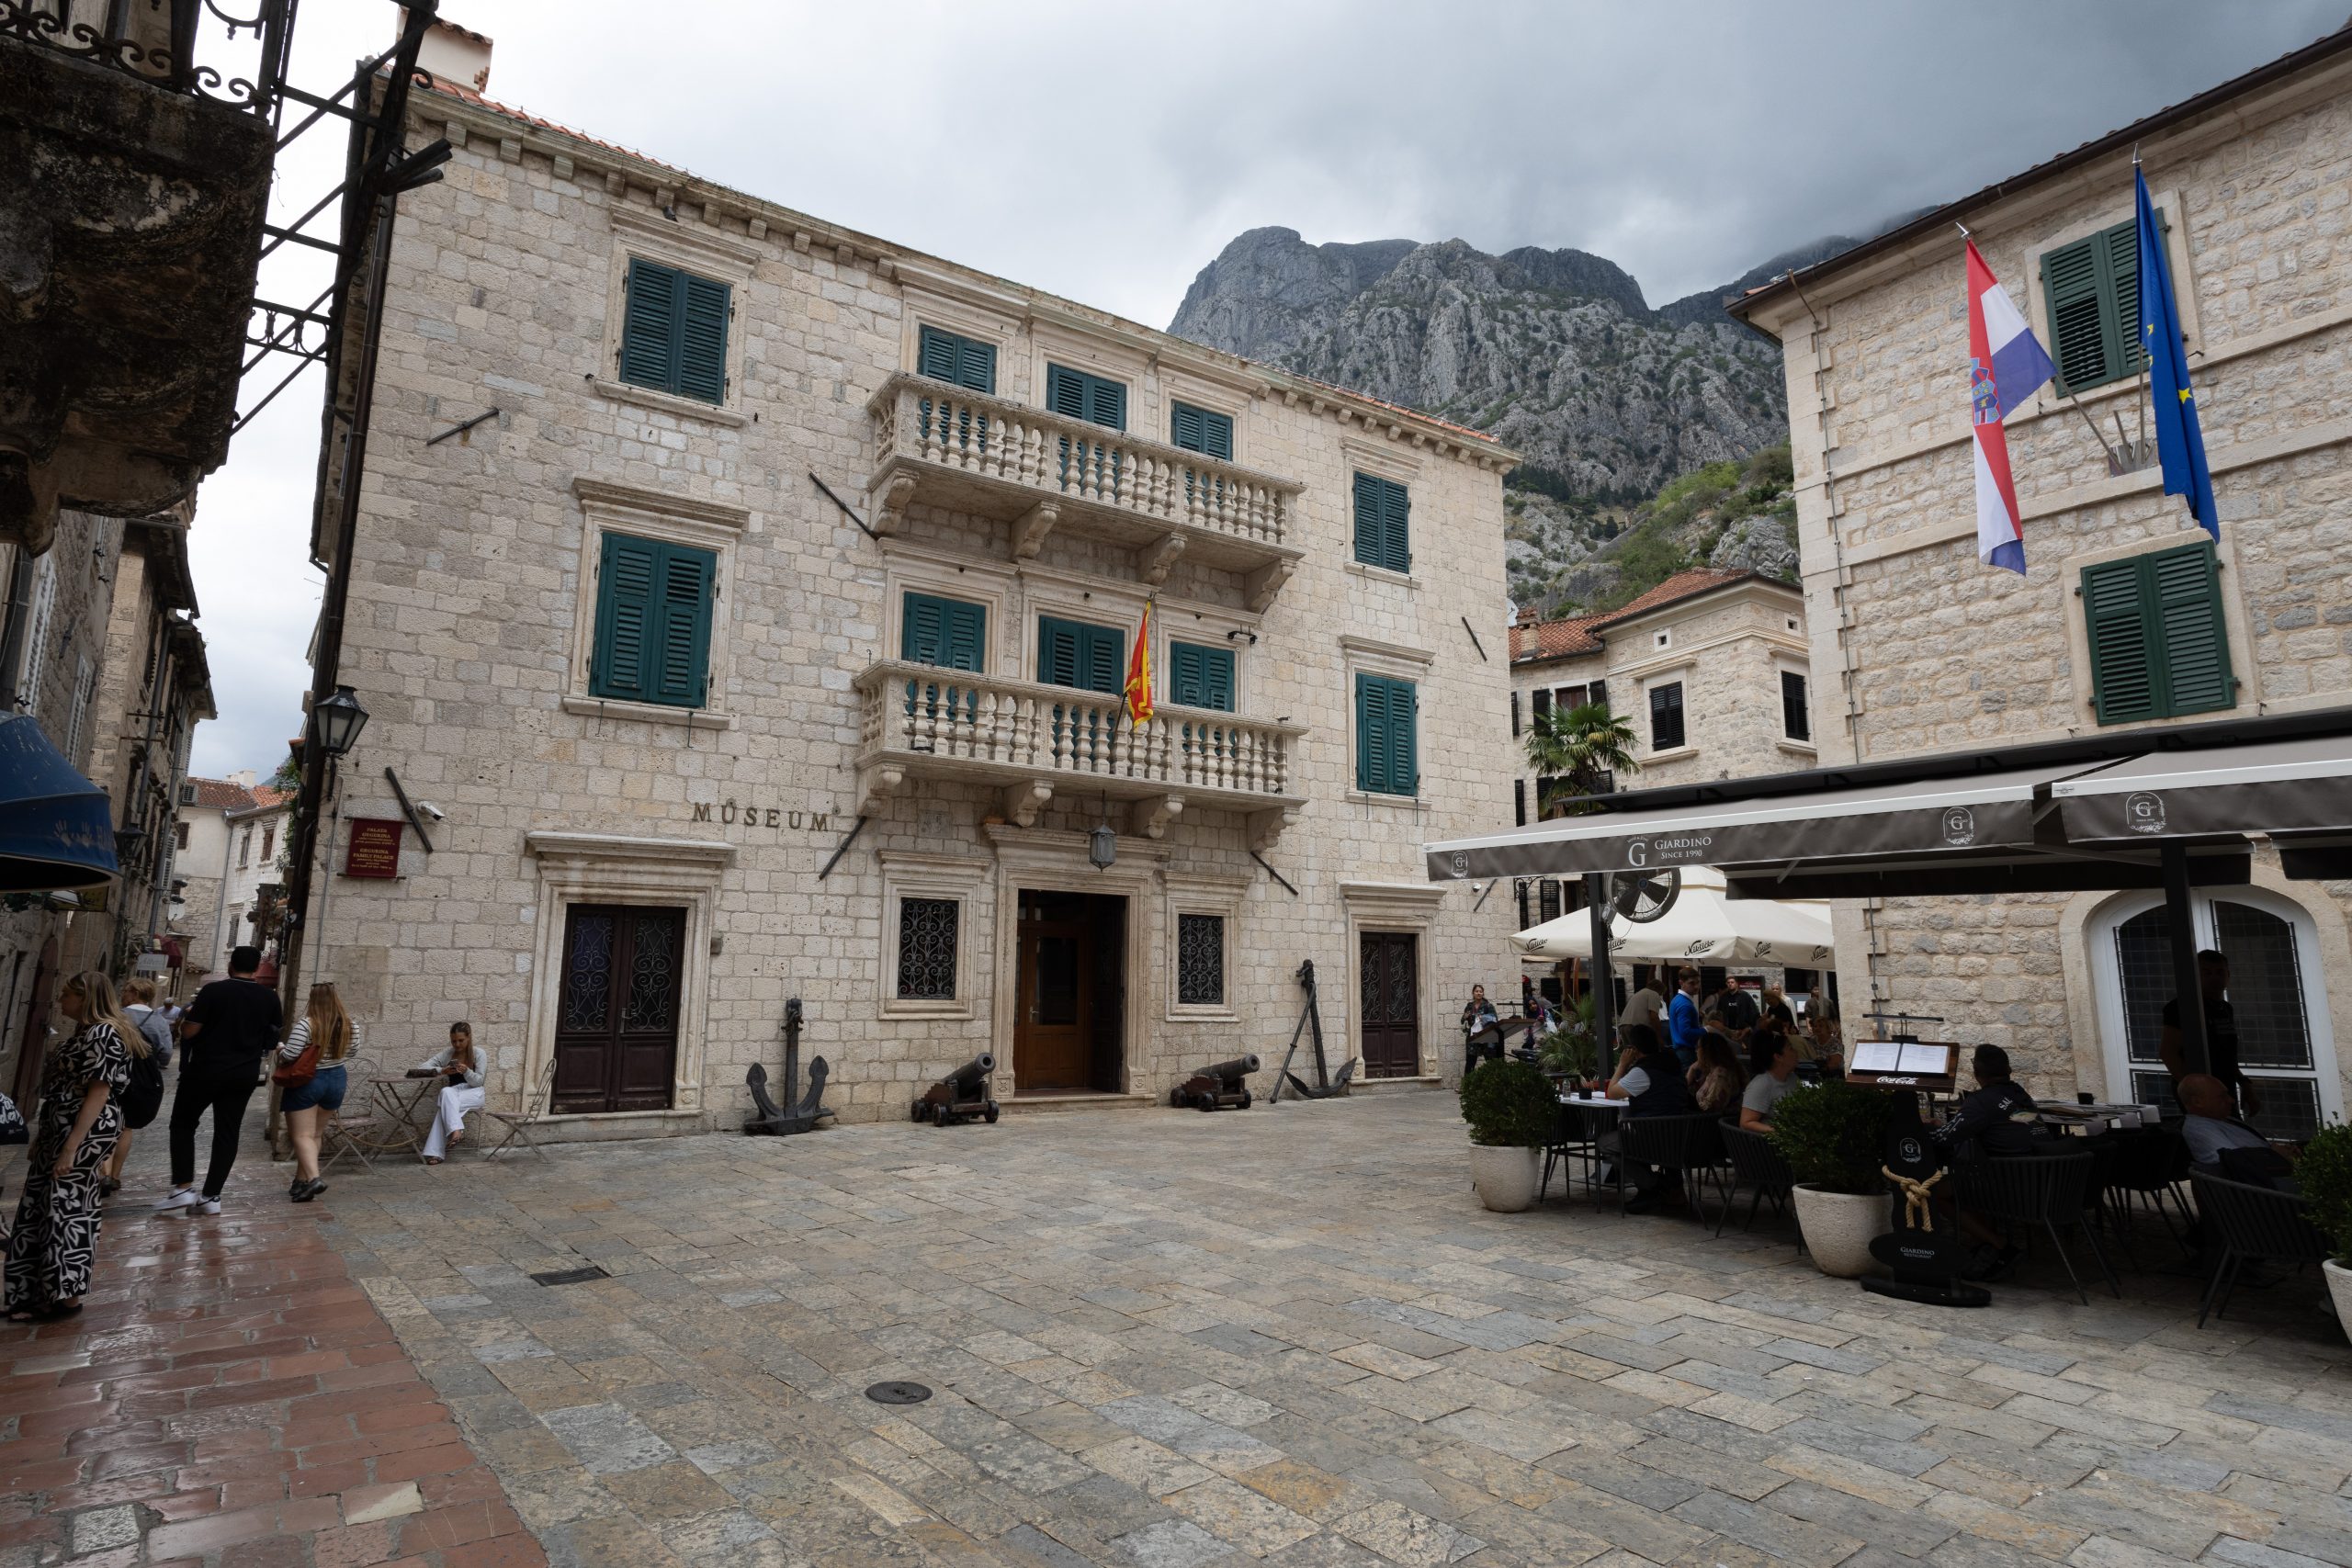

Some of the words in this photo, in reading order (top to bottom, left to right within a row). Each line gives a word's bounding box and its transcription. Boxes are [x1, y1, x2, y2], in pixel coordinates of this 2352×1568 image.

[691, 802, 828, 832] MUSEUM
[1654, 836, 1712, 851] GIARDINO
[1628, 842, 1647, 867] G
[1660, 851, 1683, 860] SINCE
[1685, 849, 1702, 858] 1990
[1900, 1247, 1935, 1256] GIARDINO
